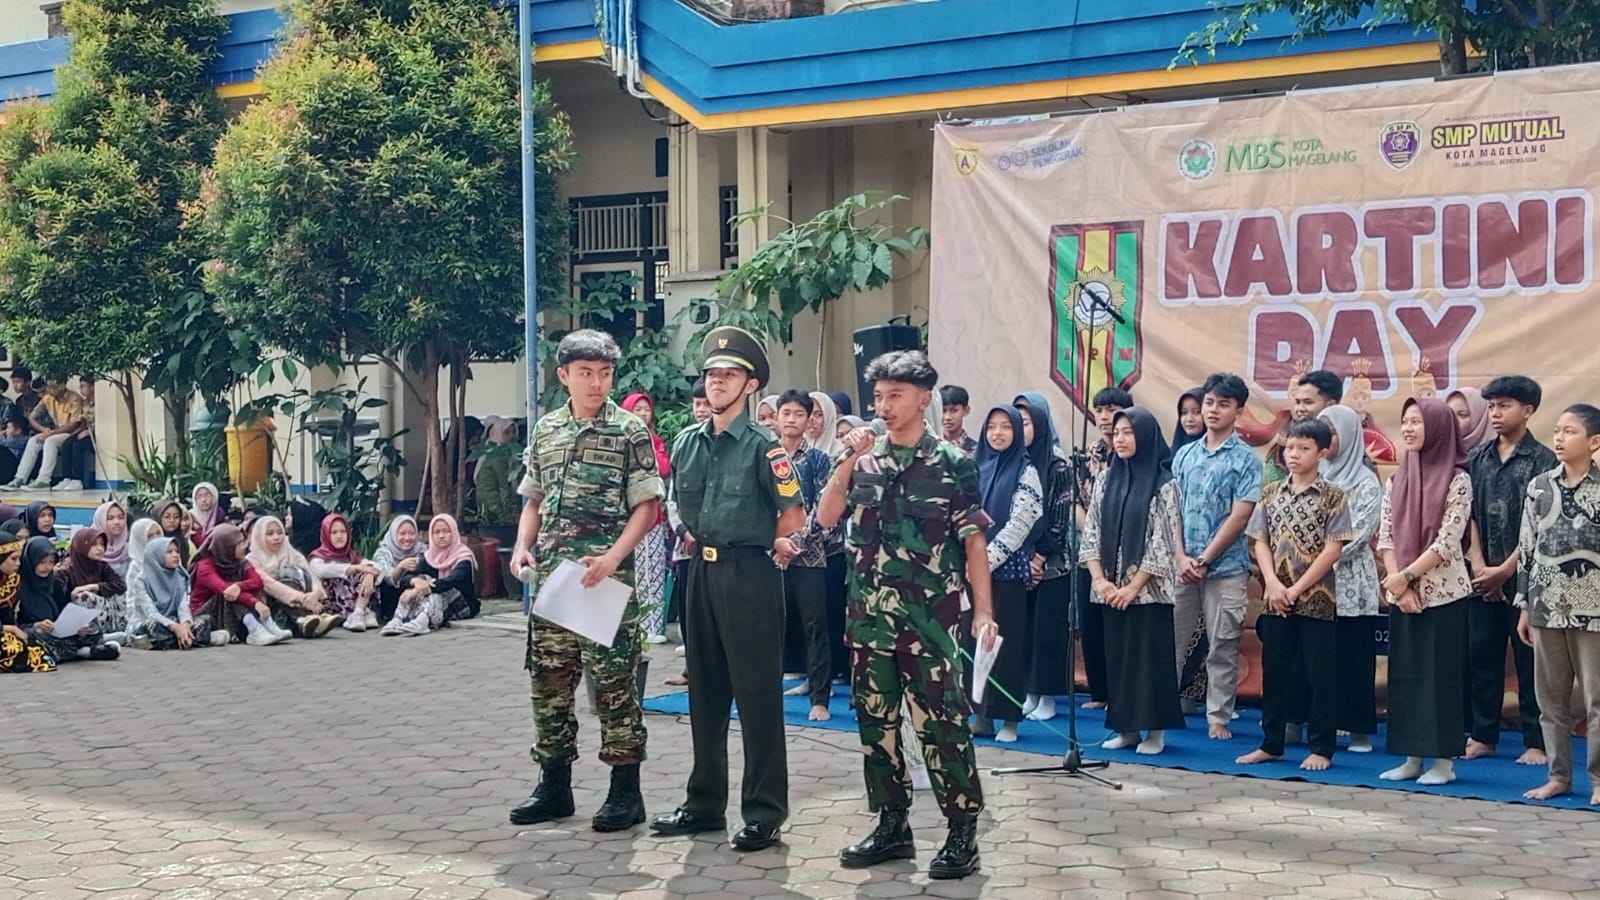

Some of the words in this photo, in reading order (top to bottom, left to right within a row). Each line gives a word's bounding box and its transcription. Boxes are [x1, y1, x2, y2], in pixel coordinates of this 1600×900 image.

[1292, 138, 1324, 152] KOTA
[1432, 124, 1477, 149] SMP
[1480, 116, 1565, 145] MUTUAL
[1225, 141, 1287, 172] MBS
[1289, 150, 1358, 168] MAGELANG
[1446, 150, 1475, 160] KOTA
[1480, 144, 1546, 157] MAGELANG
[1161, 191, 1590, 304] KARTINI
[1251, 301, 1481, 396] DAY
